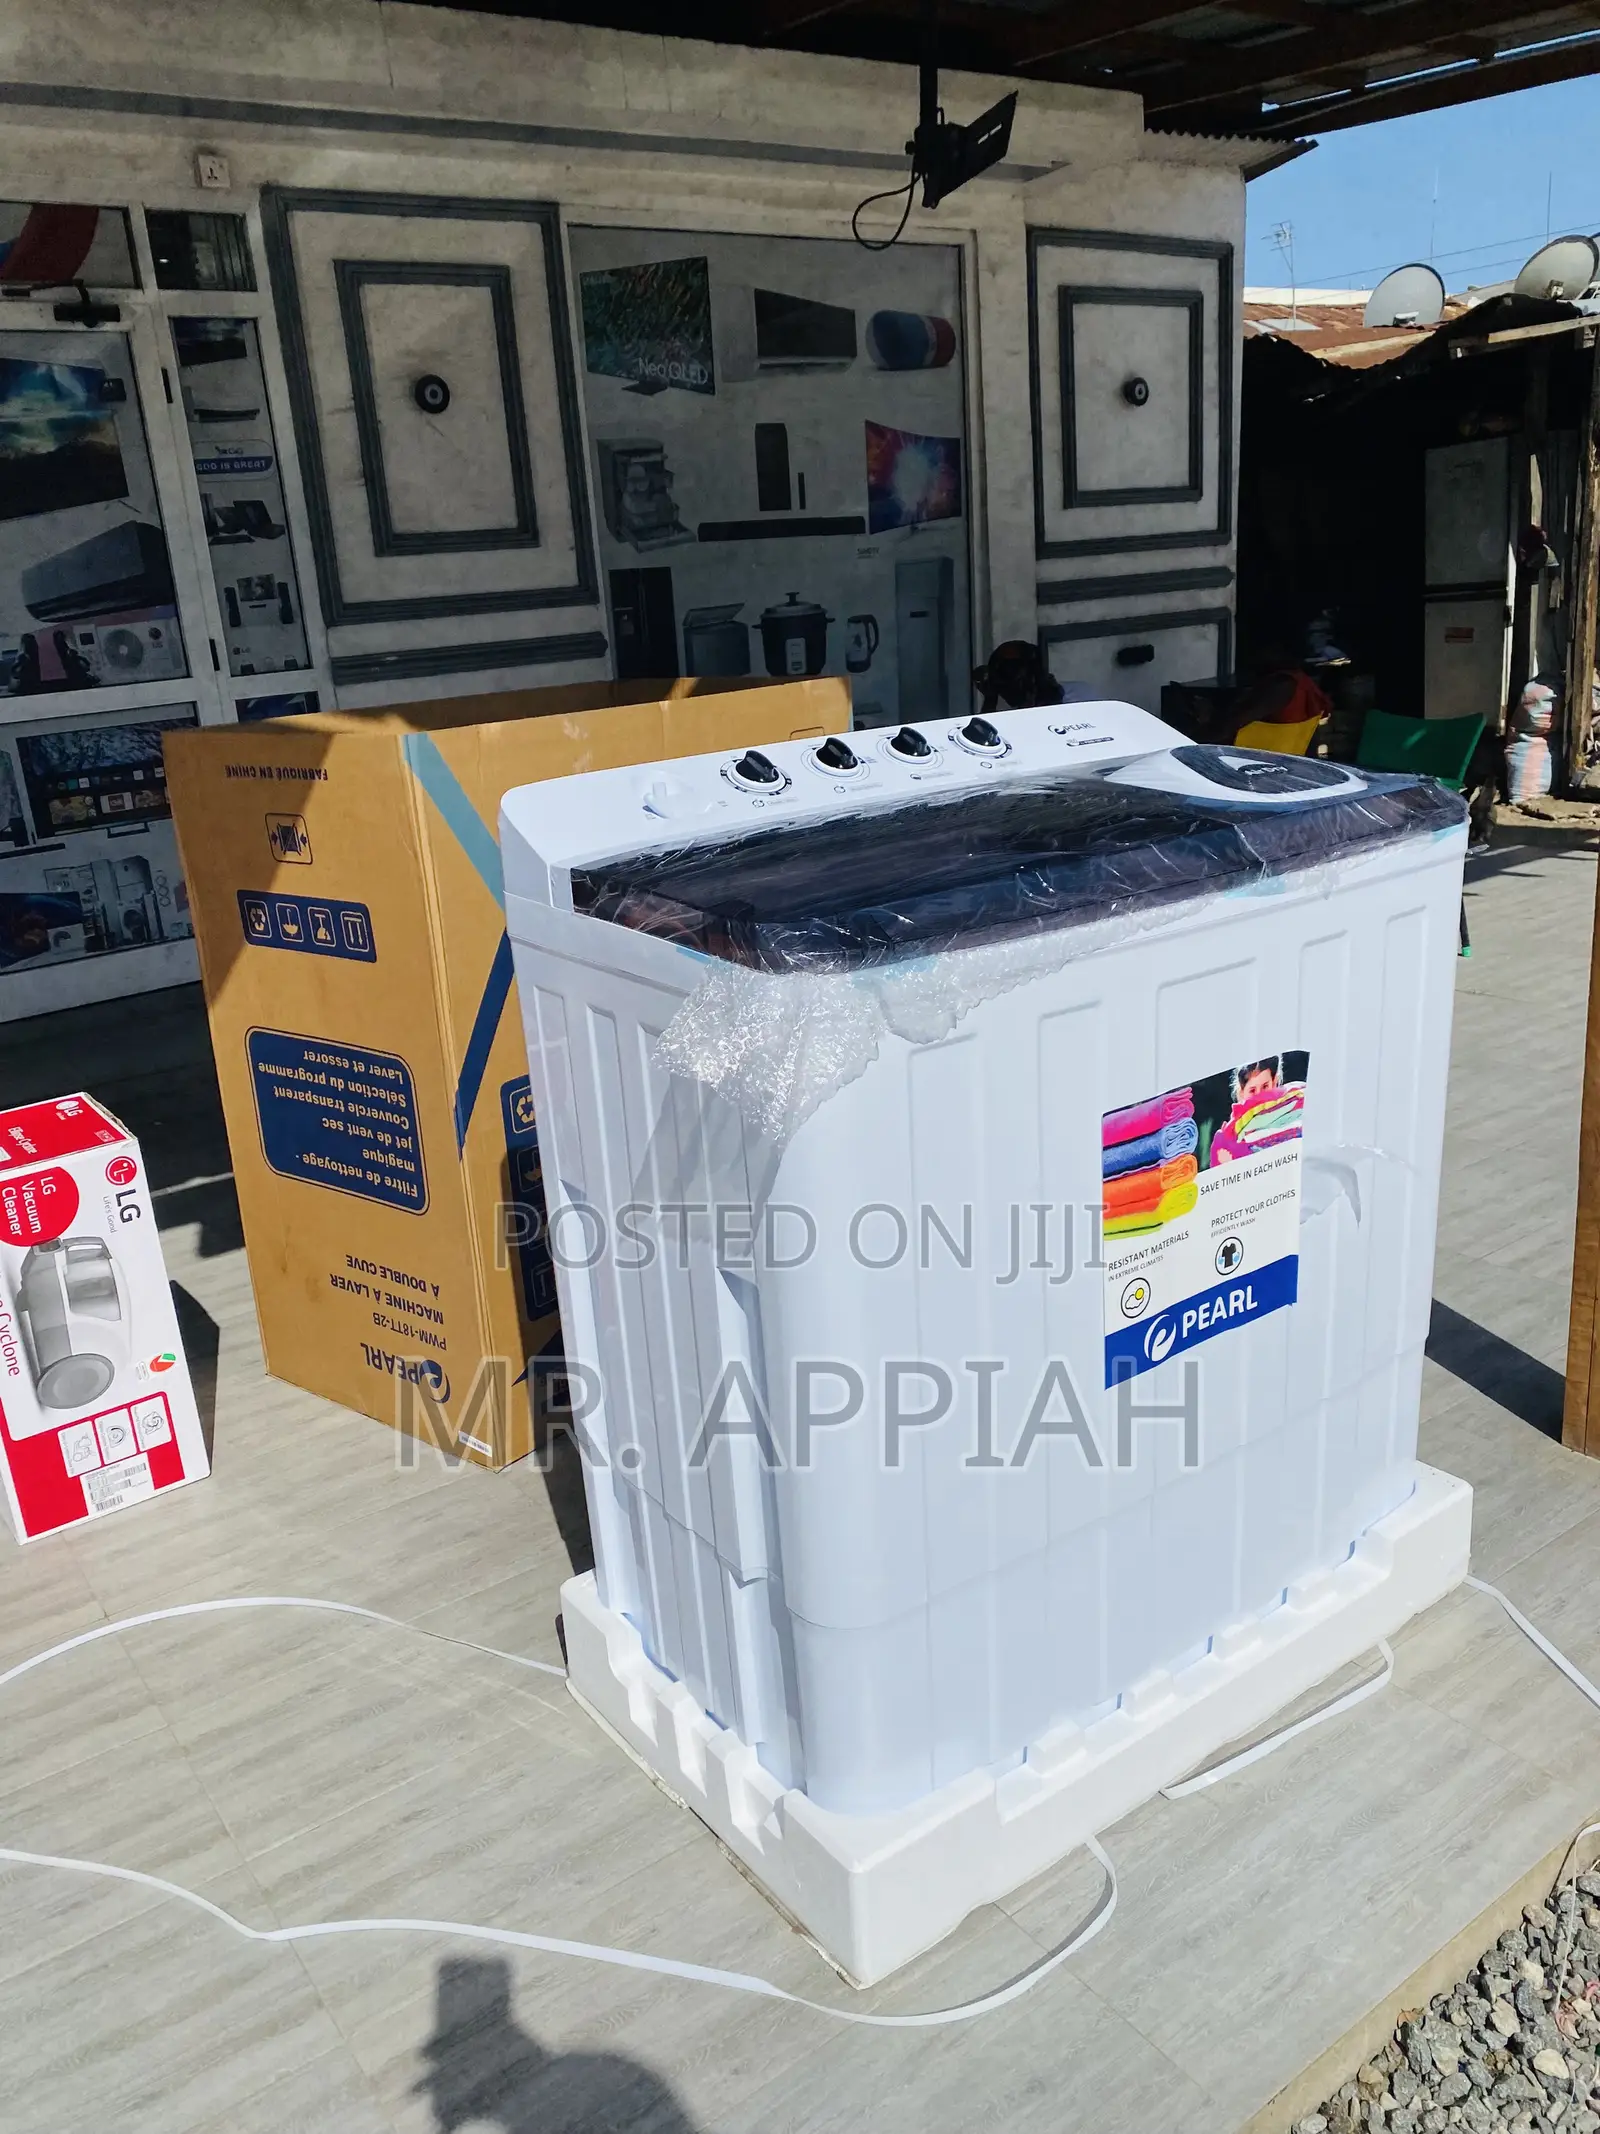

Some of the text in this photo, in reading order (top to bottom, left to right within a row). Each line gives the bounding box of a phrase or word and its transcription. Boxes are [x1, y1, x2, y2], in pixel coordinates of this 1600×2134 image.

[638, 357, 708, 385] Neo QLED
[224, 764, 328, 781] FABRIQUÉ EN CHINE
[258, 1062, 406, 1108] Sélection du programme
[303, 1050, 404, 1085] Laver et essorer
[273, 1085, 410, 1130] Couvercle transparent
[322, 1117, 413, 1153] jet de vent sec
[302, 1152, 363, 1178] nettoyage
[362, 1148, 415, 1172] magique
[366, 1170, 381, 1185] de
[1200, 1153, 1298, 1196] SAVE TIME IN EACH WASH
[40, 1176, 57, 1196] LG
[384, 1175, 418, 1198] Filtre
[1, 1186, 23, 1236] Cleaner
[21, 1180, 42, 1234] Vacuum
[103, 1195, 118, 1234] Life's Good
[115, 1188, 141, 1224] LG
[1211, 1188, 1296, 1228] PROTECT YOUR CLOTHES
[1240, 1217, 1256, 1227] WASH
[1108, 1230, 1190, 1272] RESISTANT MATERIALS
[1108, 1254, 1164, 1282] IN EXTREME CLIMATES
[345, 1254, 440, 1301] À DOUBLE CUVE
[329, 1273, 444, 1325] MACHINE À LAVER
[1182, 1285, 1258, 1339] PEARL
[372, 1312, 447, 1351] PWM-18TT-2B
[360, 1342, 420, 1386] PEARL
